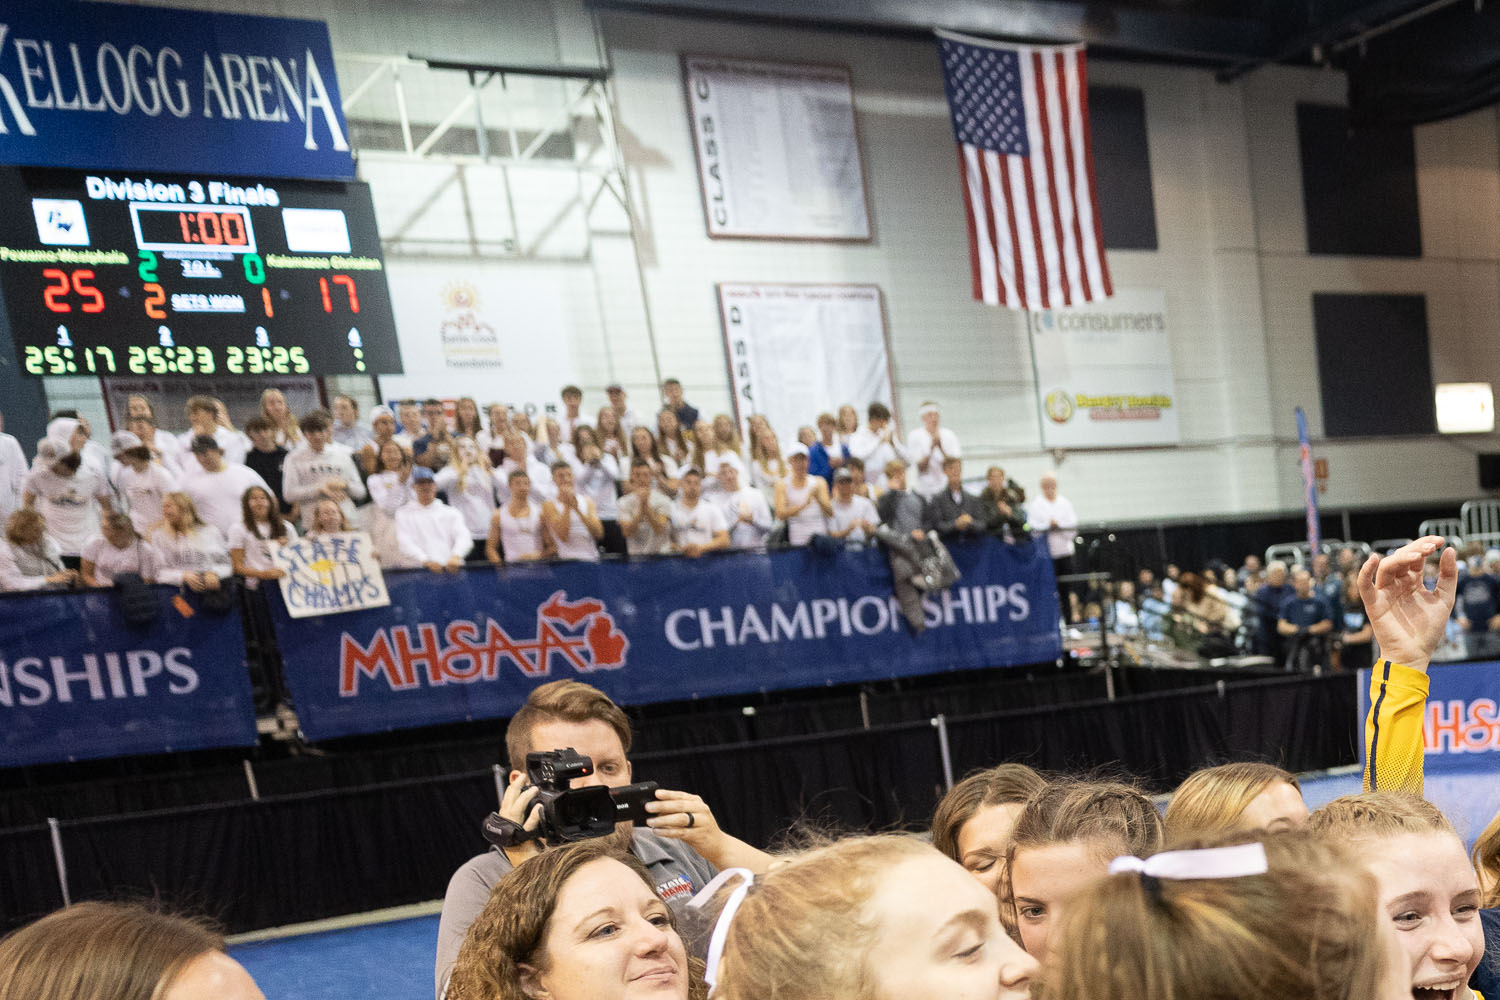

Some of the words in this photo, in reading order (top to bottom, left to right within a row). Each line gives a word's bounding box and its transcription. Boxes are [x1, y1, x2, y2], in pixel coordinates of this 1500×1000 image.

[203, 47, 350, 152] ARENA
[695, 77, 710, 101] C
[702, 115, 728, 227] CLASS
[86, 176, 186, 203] Division
[188, 180, 206, 204] 3
[208, 181, 280, 207] Finals
[179, 211, 248, 246] 1:00
[138, 249, 159, 283] 2
[243, 252, 266, 285] 0
[43, 269, 105, 313] 25
[143, 282, 167, 319] 2
[262, 287, 274, 318] 1
[320, 275, 360, 313] 17
[57, 324, 73, 347] 1
[158, 325, 175, 347] 2
[255, 325, 271, 347] 3
[1057, 312, 1165, 332] consumers
[25, 346, 117, 374] 25:17
[129, 346, 216, 374] 25:23
[226, 346, 310, 374] 23:25
[278, 537, 361, 573] STATE
[287, 576, 380, 609] CHAMPS
[339, 614, 594, 698] MHSAA
